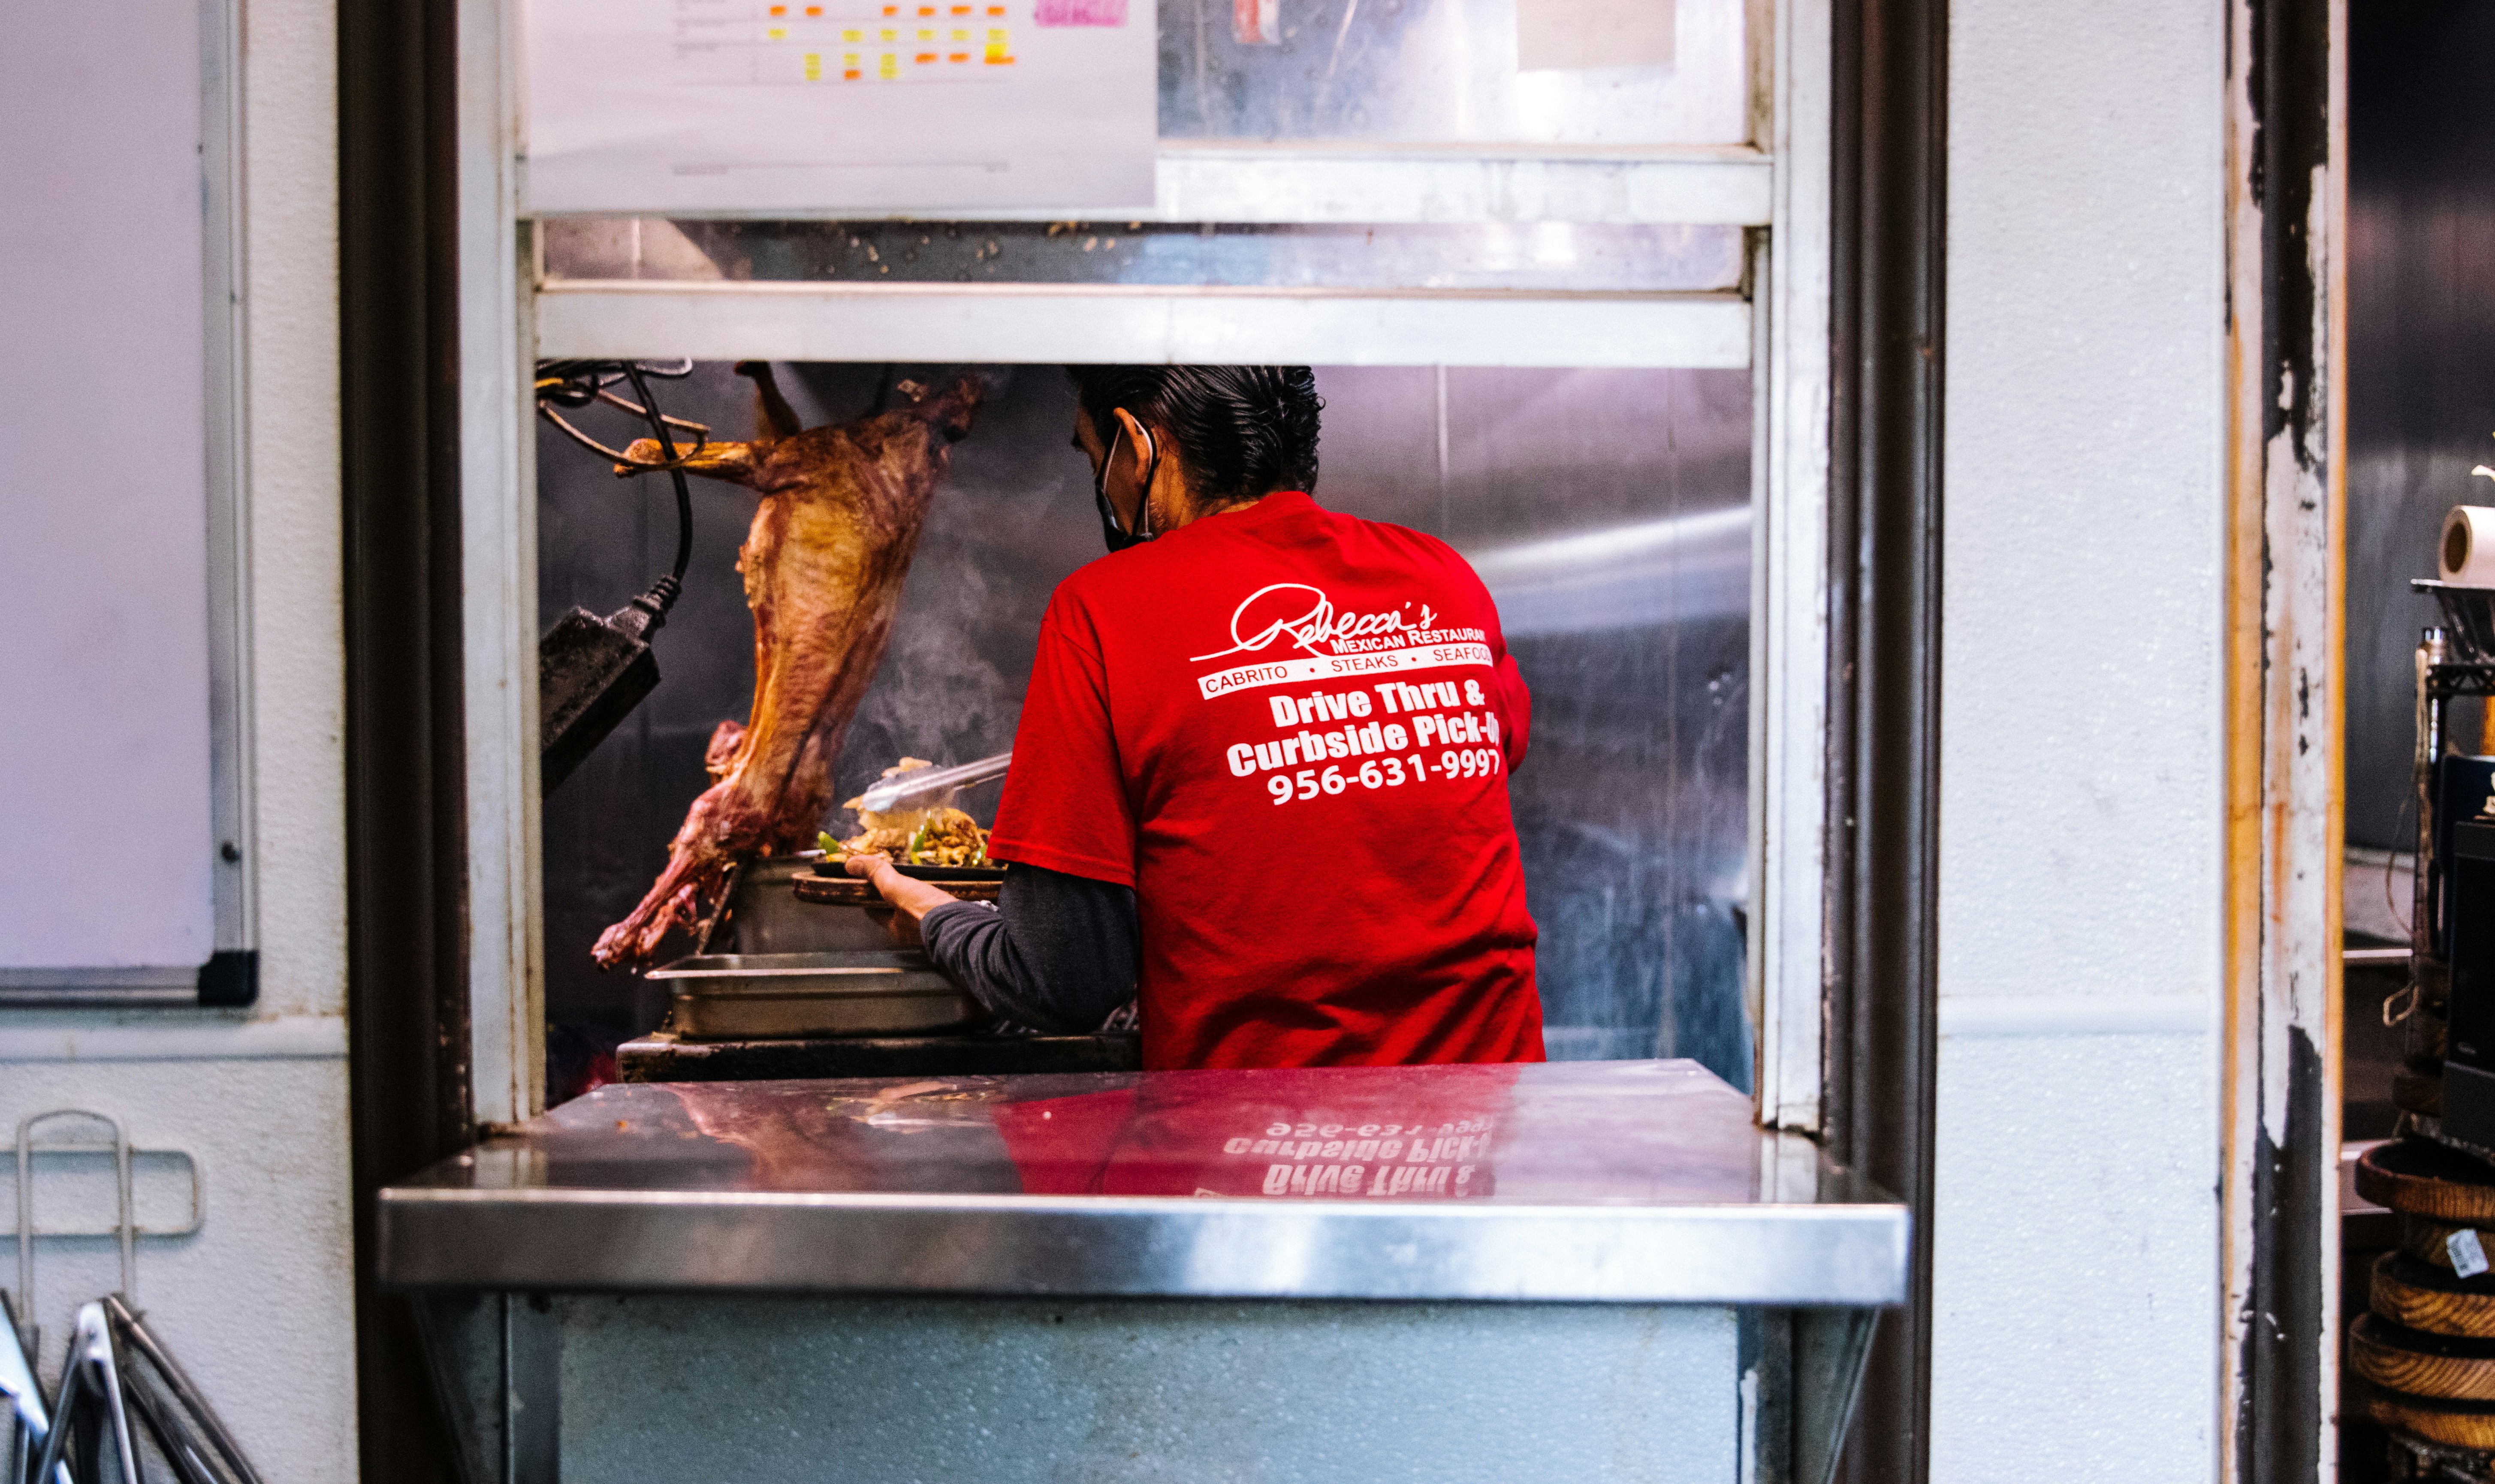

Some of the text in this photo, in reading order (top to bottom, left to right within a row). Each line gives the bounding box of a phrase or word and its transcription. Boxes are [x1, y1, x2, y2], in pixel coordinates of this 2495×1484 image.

[1190, 583, 1437, 662] Rebecca's
[1330, 628, 1487, 654] MEXICAN RESTAURAN
[1205, 666, 1287, 693] CABRITO
[1331, 654, 1399, 672] STEAKS
[1269, 679, 1485, 728] Drive Thru &
[1227, 721, 1409, 777] Curbside
[1267, 748, 1500, 805] 956-631-9997
